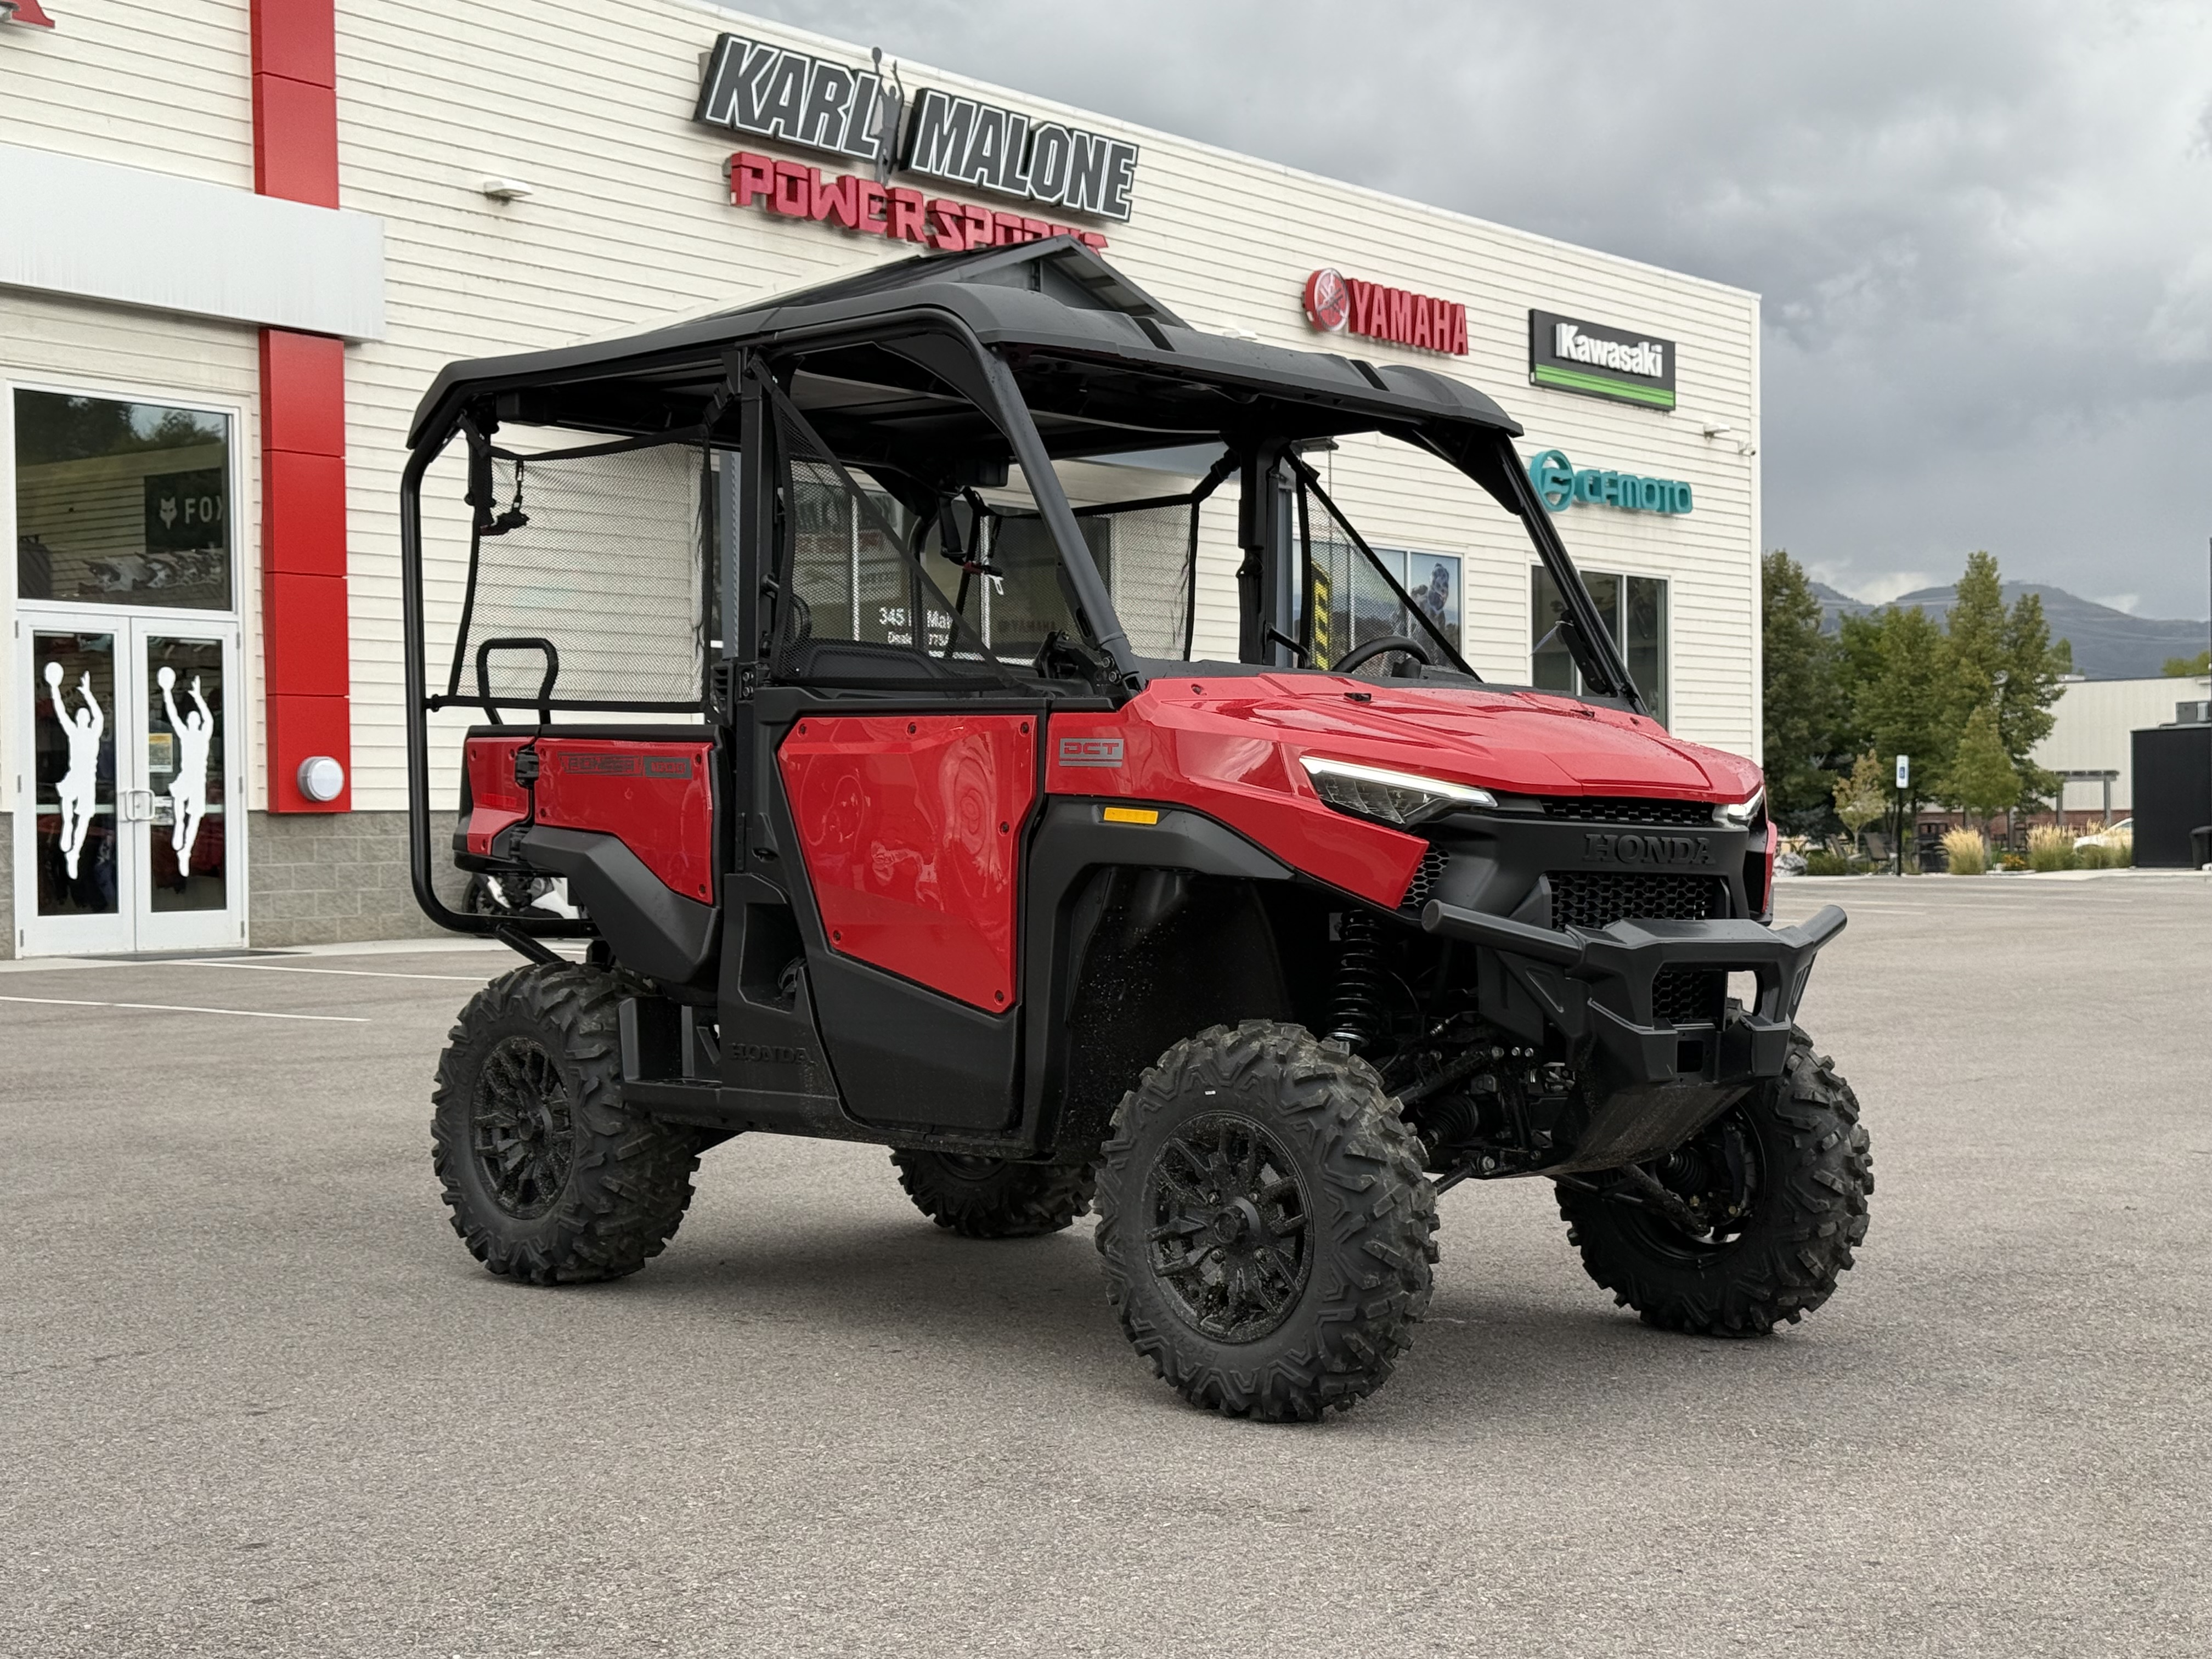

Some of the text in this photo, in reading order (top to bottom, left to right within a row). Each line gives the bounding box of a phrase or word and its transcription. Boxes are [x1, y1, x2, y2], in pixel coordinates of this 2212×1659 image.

[702, 35, 1139, 221] KARL MALONE
[731, 151, 1108, 255] POWERSPO
[1347, 278, 1469, 356] YAMAHA
[1556, 323, 1663, 377] Kawasaki
[1576, 469, 1693, 514] CFMOTO
[879, 607, 905, 627] 345
[1064, 742, 1120, 755] DCT
[1583, 833, 1716, 865] HONDA
[728, 1042, 814, 1065] HONDA
